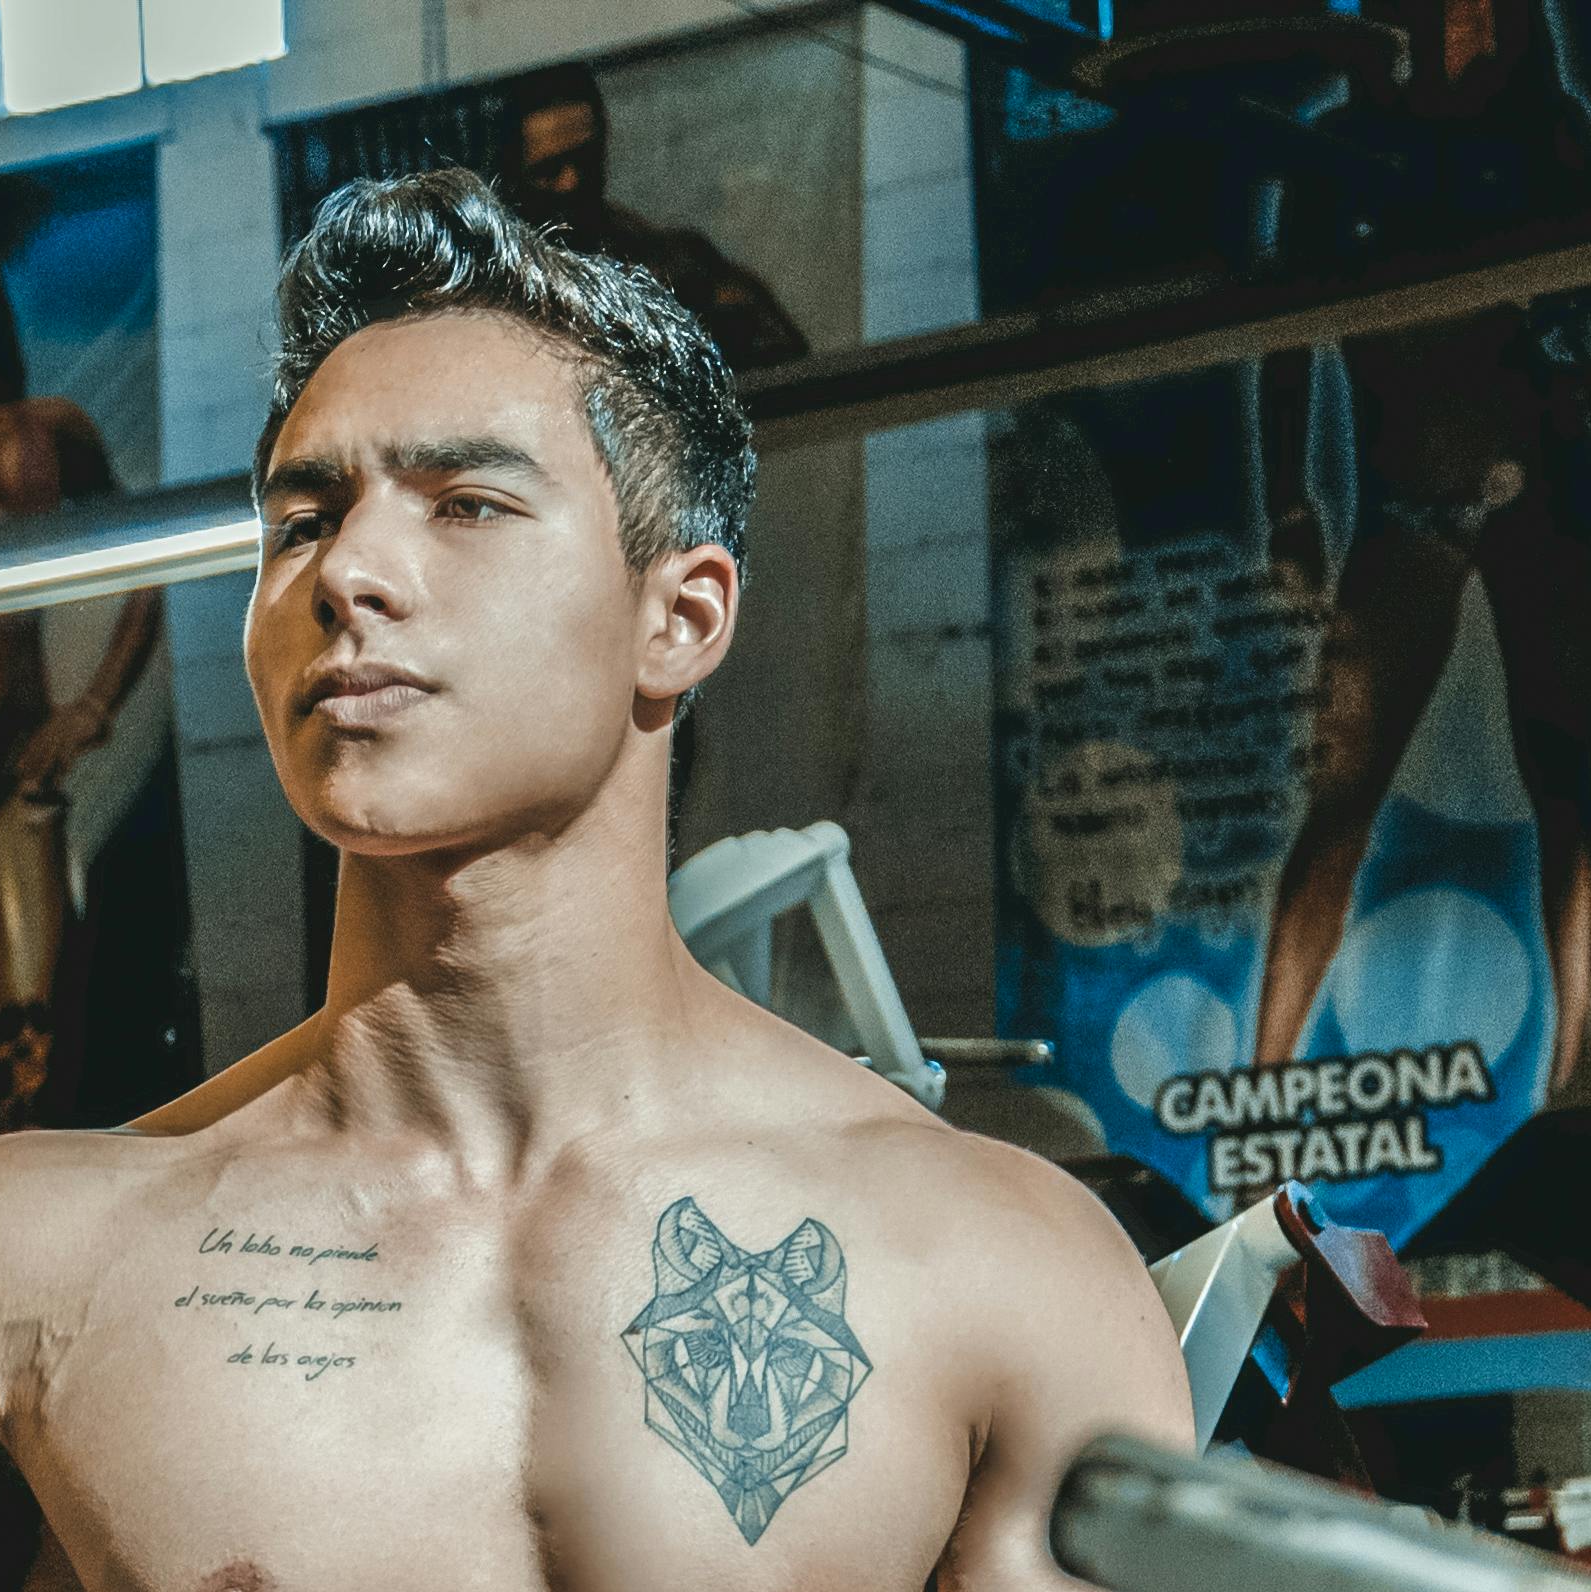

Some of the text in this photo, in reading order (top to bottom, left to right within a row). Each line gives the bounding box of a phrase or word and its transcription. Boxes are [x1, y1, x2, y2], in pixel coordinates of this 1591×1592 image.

[1158, 1045, 1492, 1134] CAMPEONA
[1210, 1115, 1440, 1188] ESTATAL
[198, 1228, 234, 1254] Un
[239, 1233, 281, 1256] lobo
[289, 1245, 314, 1258] no
[174, 1286, 199, 1307] el
[201, 1291, 256, 1306] sueño
[254, 1297, 298, 1314] por
[304, 1290, 326, 1311] la
[227, 1342, 356, 1381] de las ovejas
